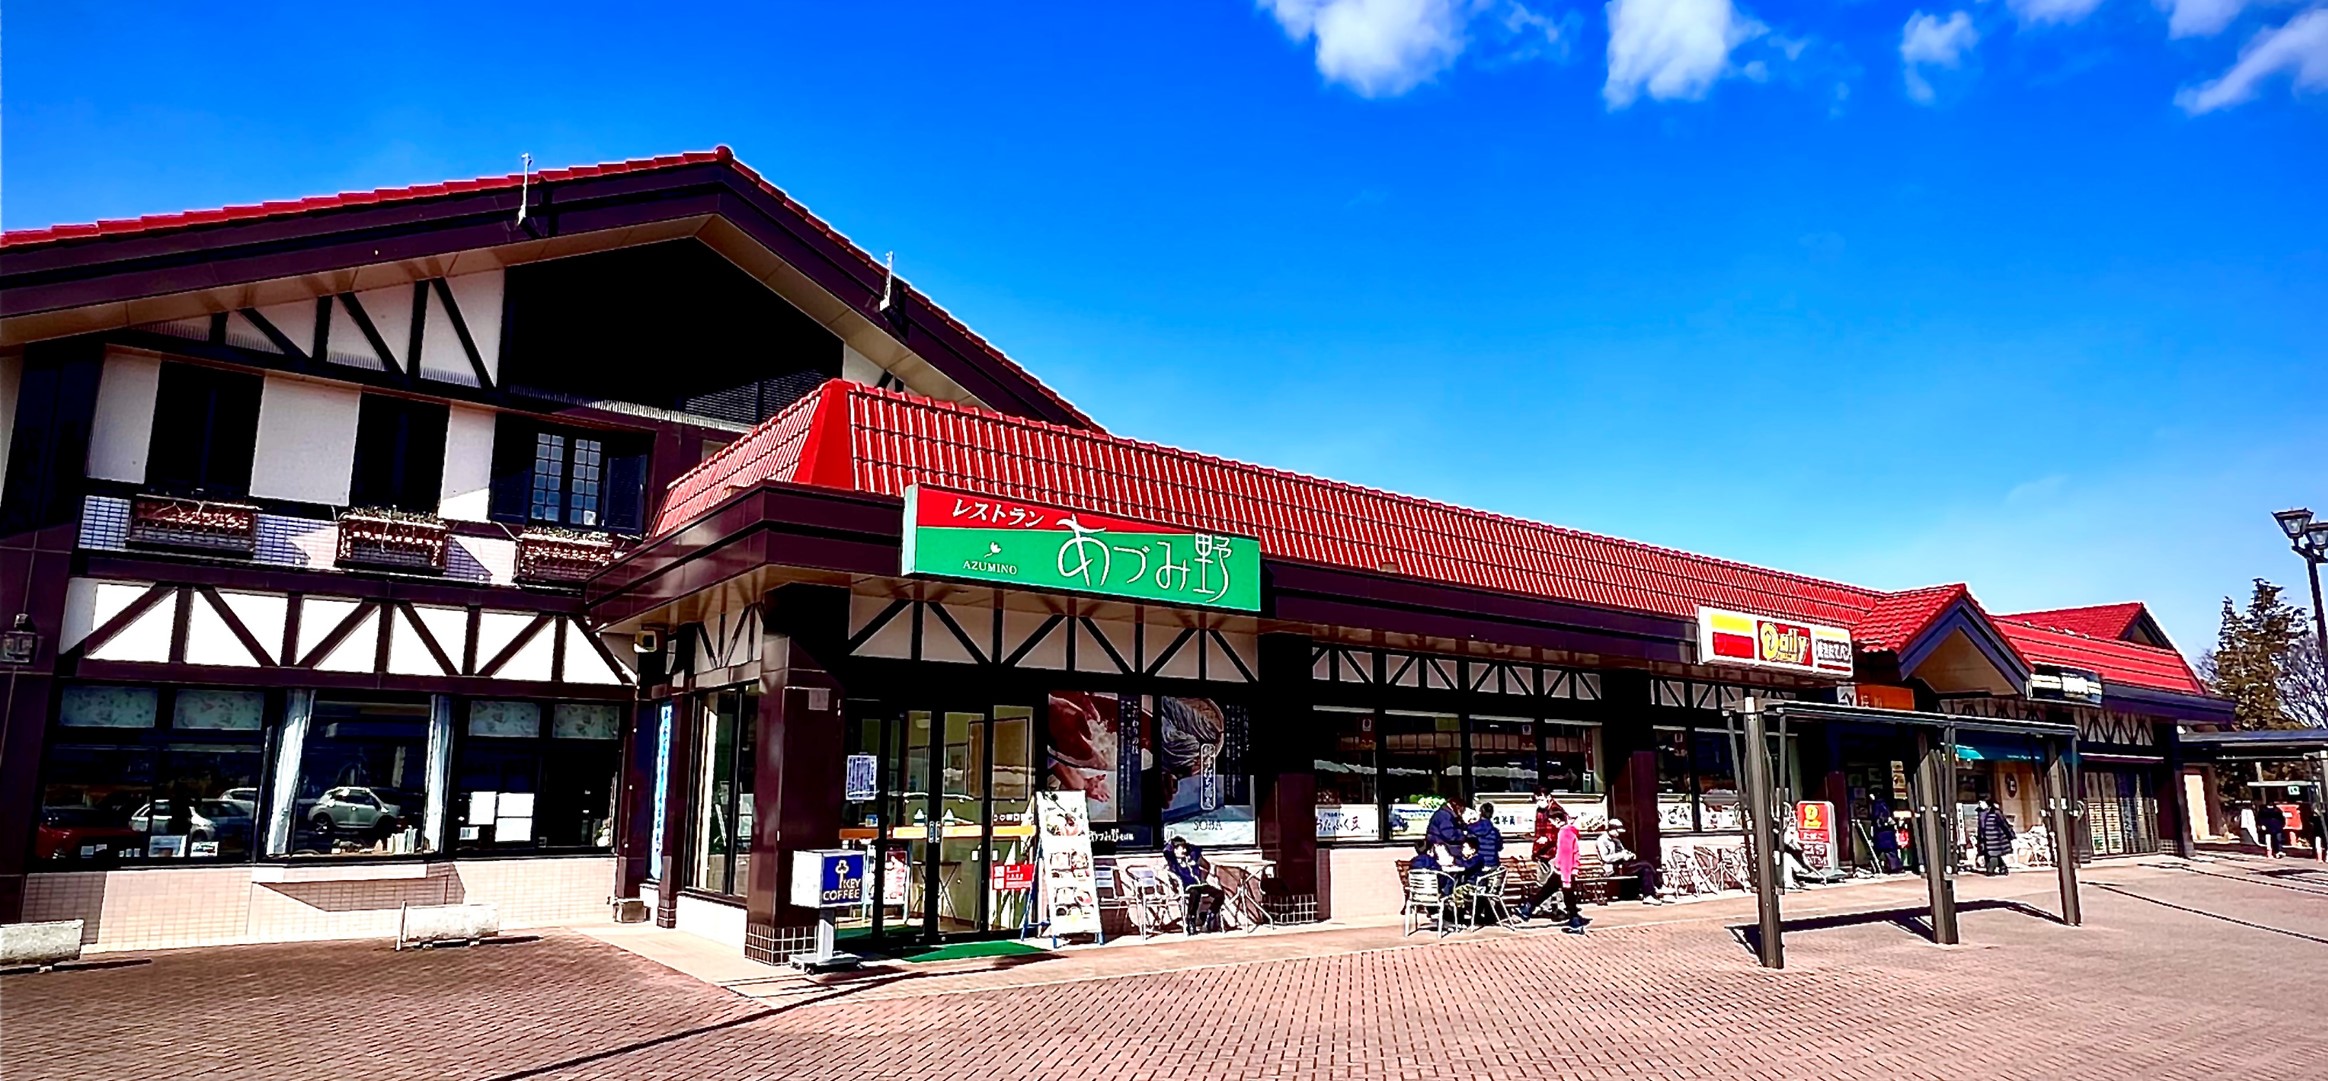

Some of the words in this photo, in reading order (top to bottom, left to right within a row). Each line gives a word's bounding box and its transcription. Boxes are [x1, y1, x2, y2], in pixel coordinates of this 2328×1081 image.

[952, 498, 1044, 528] レストラン
[1056, 514, 1233, 603] あづみ野
[962, 560, 1018, 576] AZUMINO
[1760, 621, 1810, 664] Daily
[1193, 819, 1223, 831] SOBA
[841, 878, 861, 889] KEY
[823, 889, 860, 901] COFFEE
